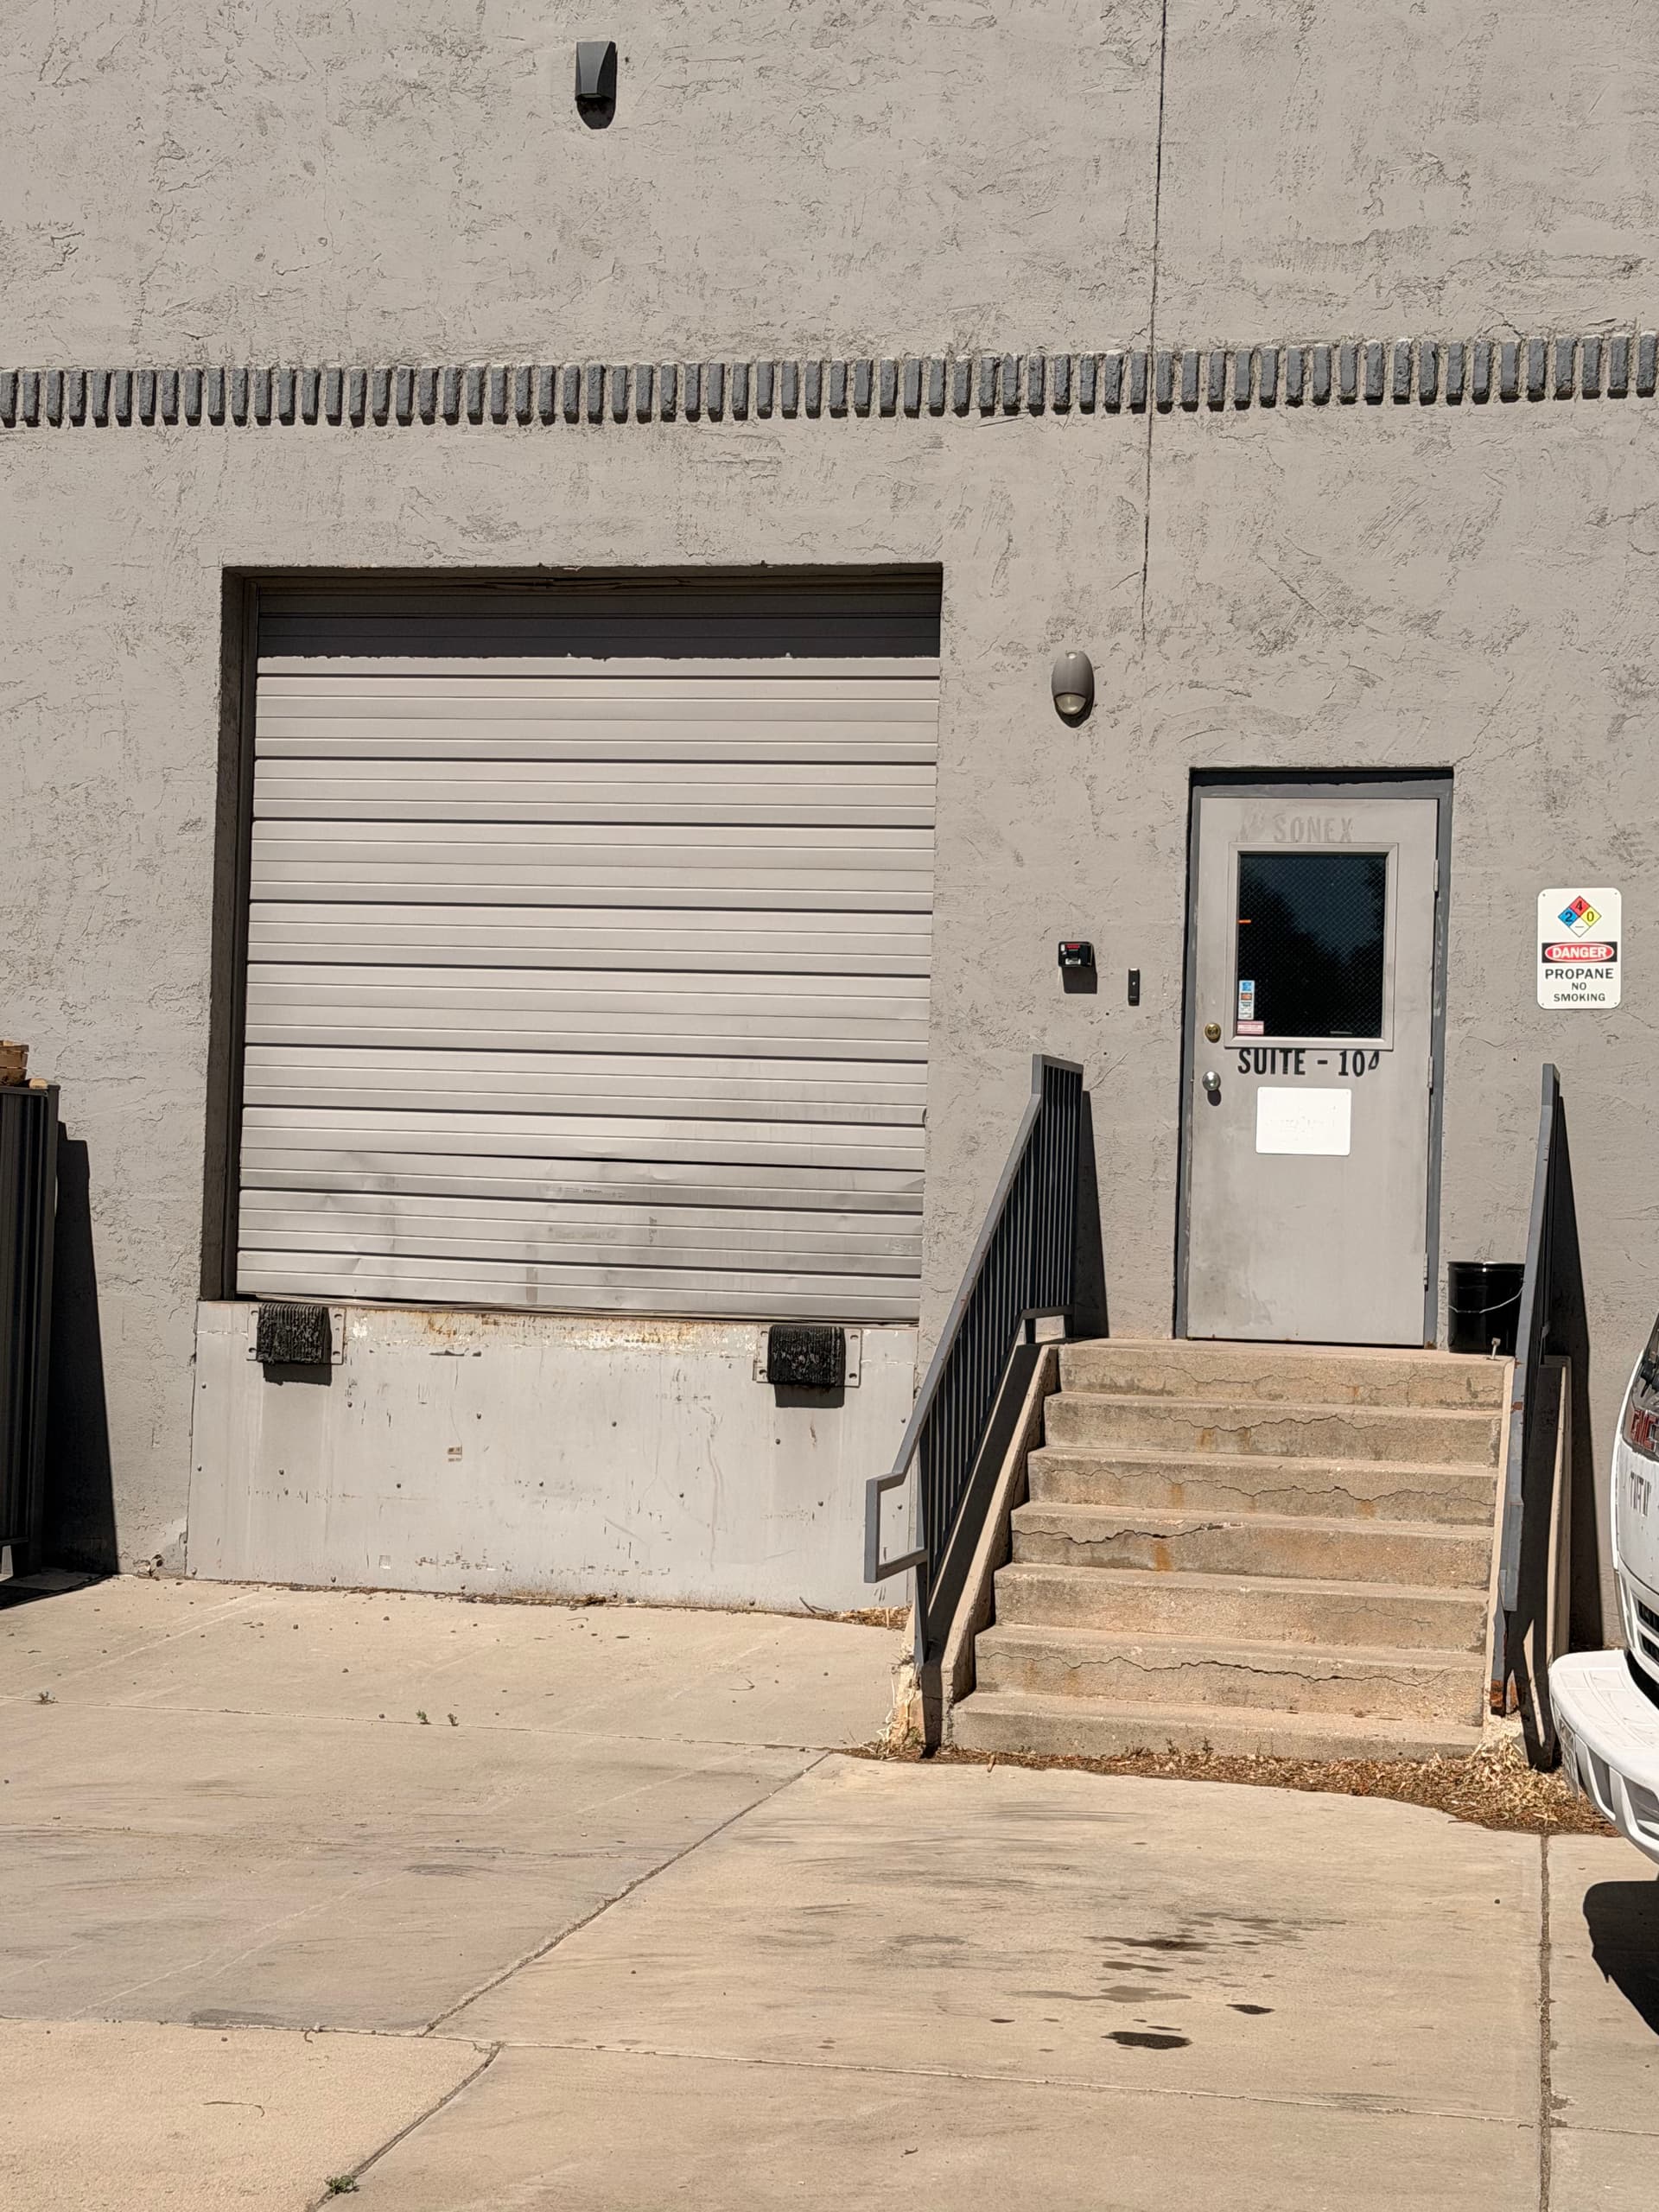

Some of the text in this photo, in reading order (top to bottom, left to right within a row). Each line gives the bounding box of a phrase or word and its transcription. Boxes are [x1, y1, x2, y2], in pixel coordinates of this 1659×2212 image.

[1576, 901, 1583, 912] 4
[1565, 912, 1594, 922] 2 0
[1552, 947, 1607, 958] DANGER
[1545, 968, 1614, 979] PROPANE
[1571, 982, 1587, 990] NO
[1554, 993, 1605, 1001] SMOKING
[1237, 1048, 1306, 1075] SUITE
